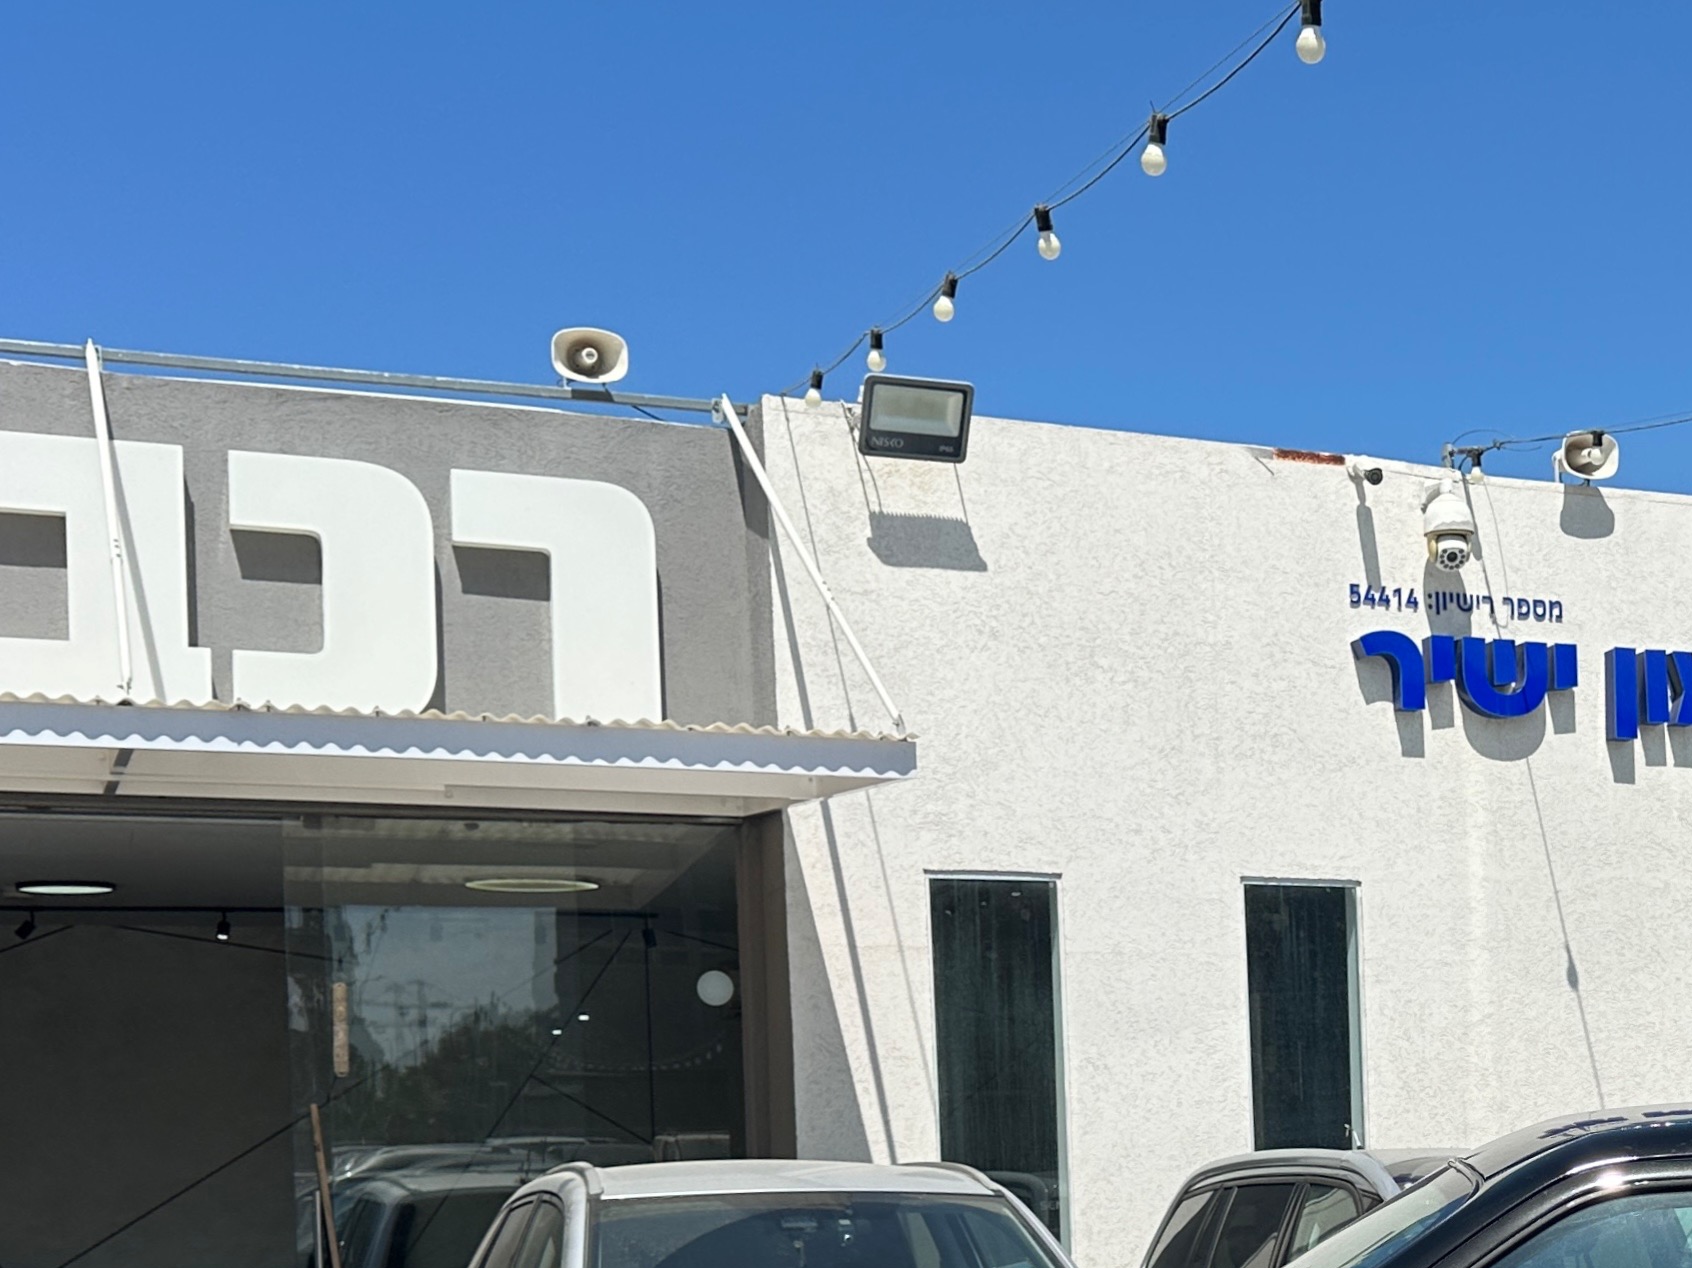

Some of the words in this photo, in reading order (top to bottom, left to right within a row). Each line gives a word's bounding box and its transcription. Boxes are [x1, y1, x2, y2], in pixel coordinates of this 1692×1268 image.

[1349, 583, 1419, 611] 54414
[1427, 590, 1495, 616] רישיון:
[1502, 596, 1564, 624] מספר
[1350, 630, 1579, 719] ישיר
